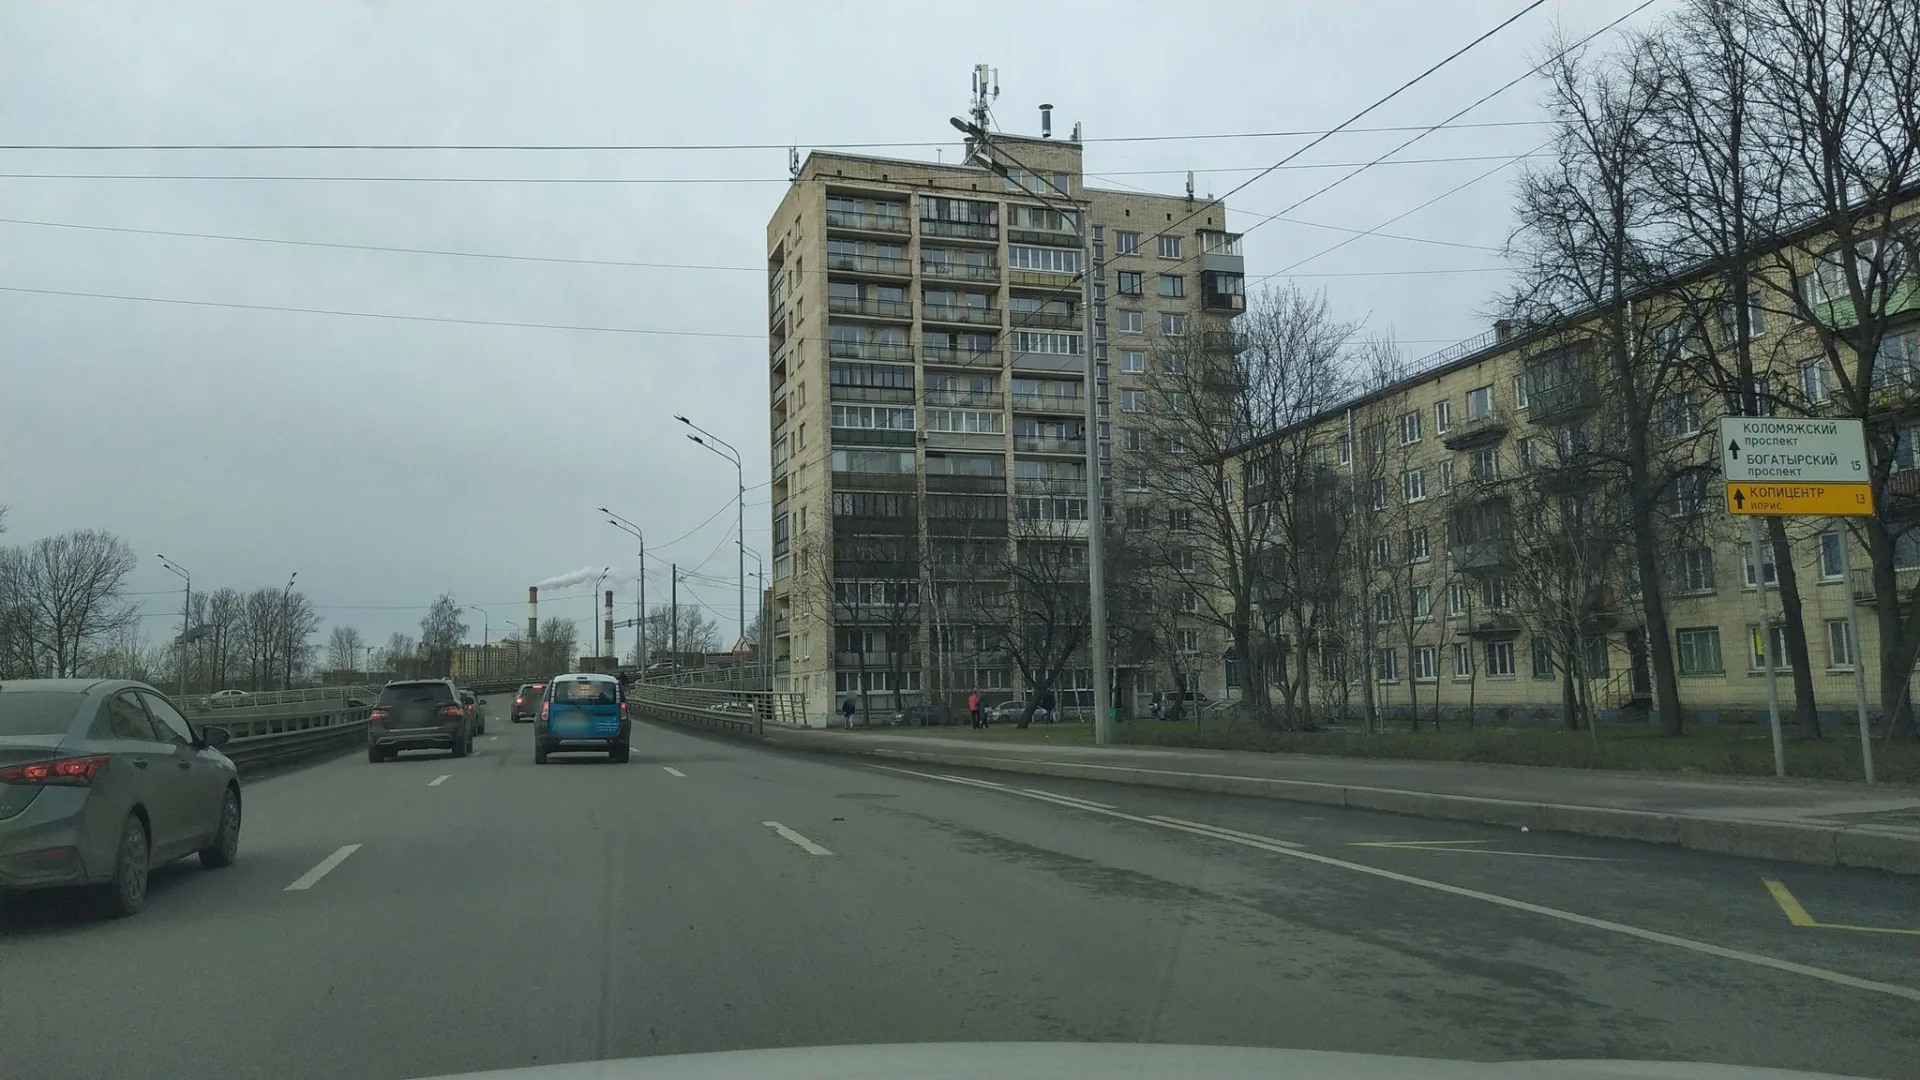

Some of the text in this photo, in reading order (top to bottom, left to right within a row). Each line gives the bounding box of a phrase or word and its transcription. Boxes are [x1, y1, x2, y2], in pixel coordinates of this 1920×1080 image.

[1743, 422, 1837, 435] КОЛОМЯЖСКИЙ
[1744, 437, 1798, 447] проспект
[1747, 452, 1838, 466] БОГАТЫРСКИЙ
[1748, 467, 1802, 478] проспект
[1750, 487, 1825, 500] КОПИЦЕНТР
[1751, 502, 1783, 510] ИПРИС
